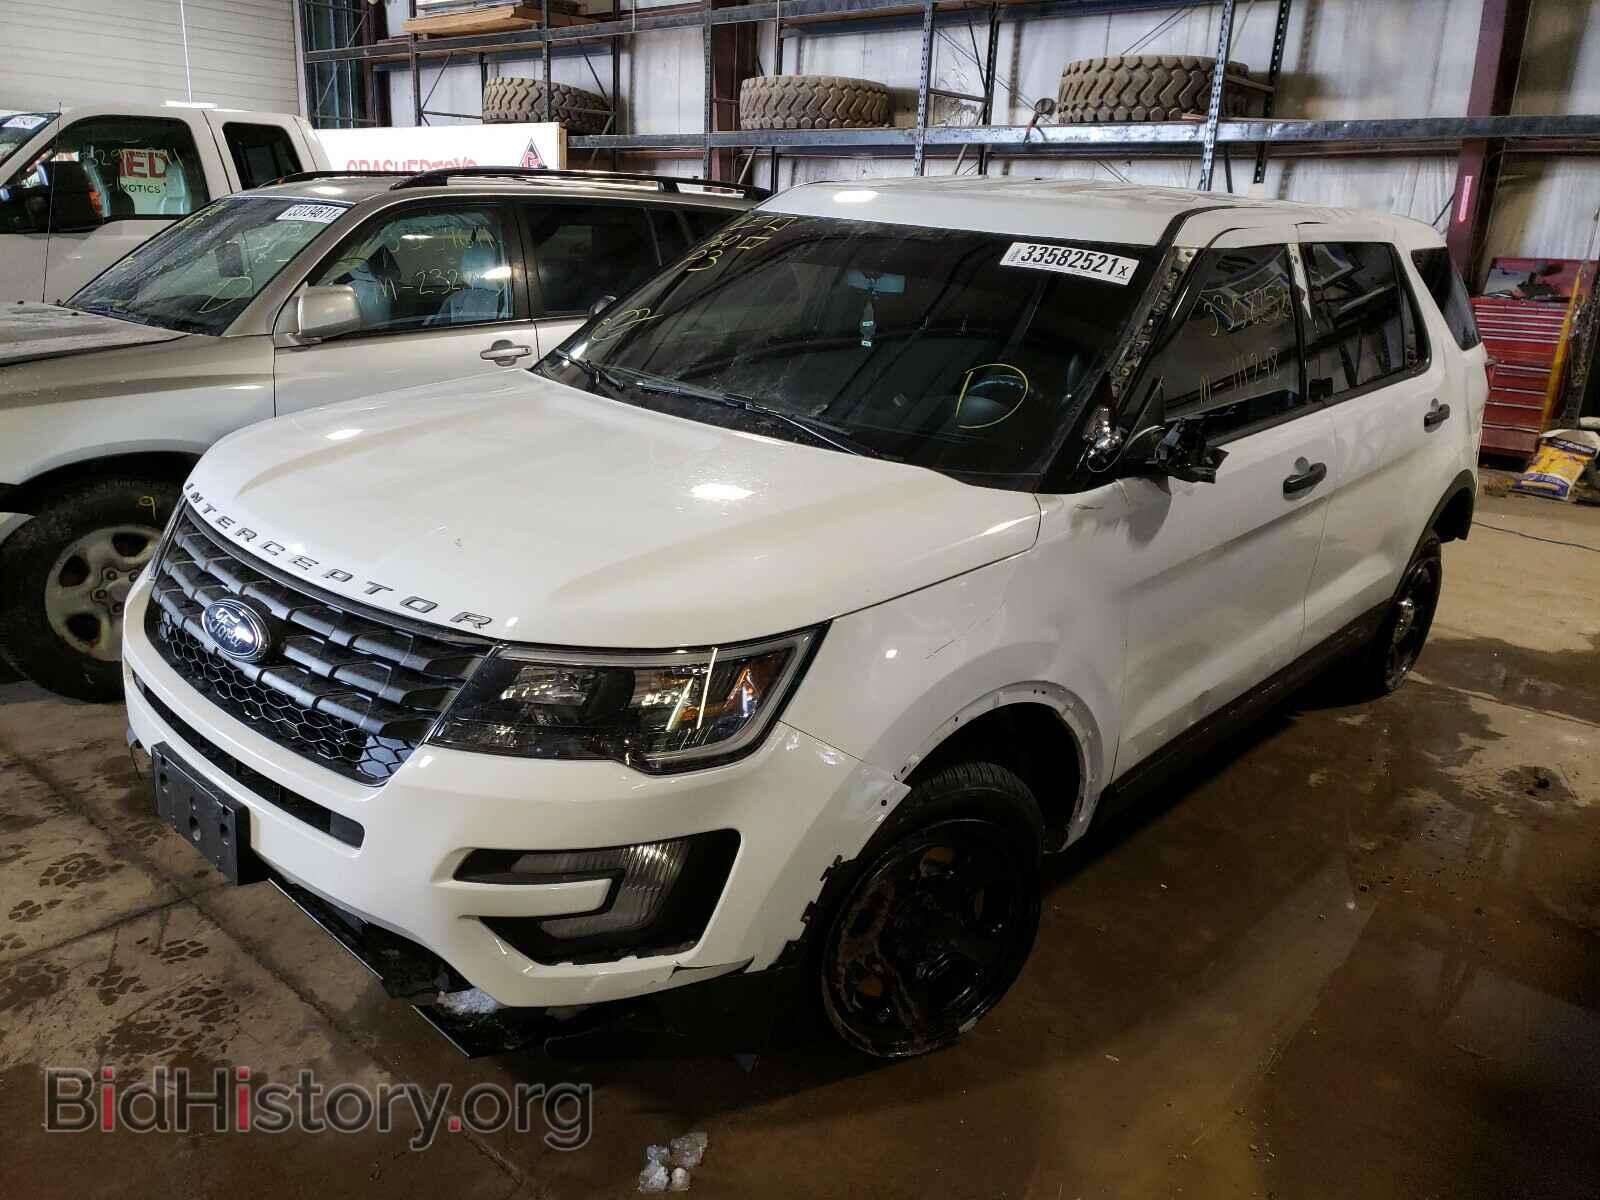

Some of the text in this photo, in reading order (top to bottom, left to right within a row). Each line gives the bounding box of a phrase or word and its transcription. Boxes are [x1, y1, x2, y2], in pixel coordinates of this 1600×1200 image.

[120, 183, 161, 194] XOTICS
[1020, 245, 1120, 275] 33582521
[185, 482, 494, 630] INTERCEPTOR
[208, 607, 247, 648] Ford
